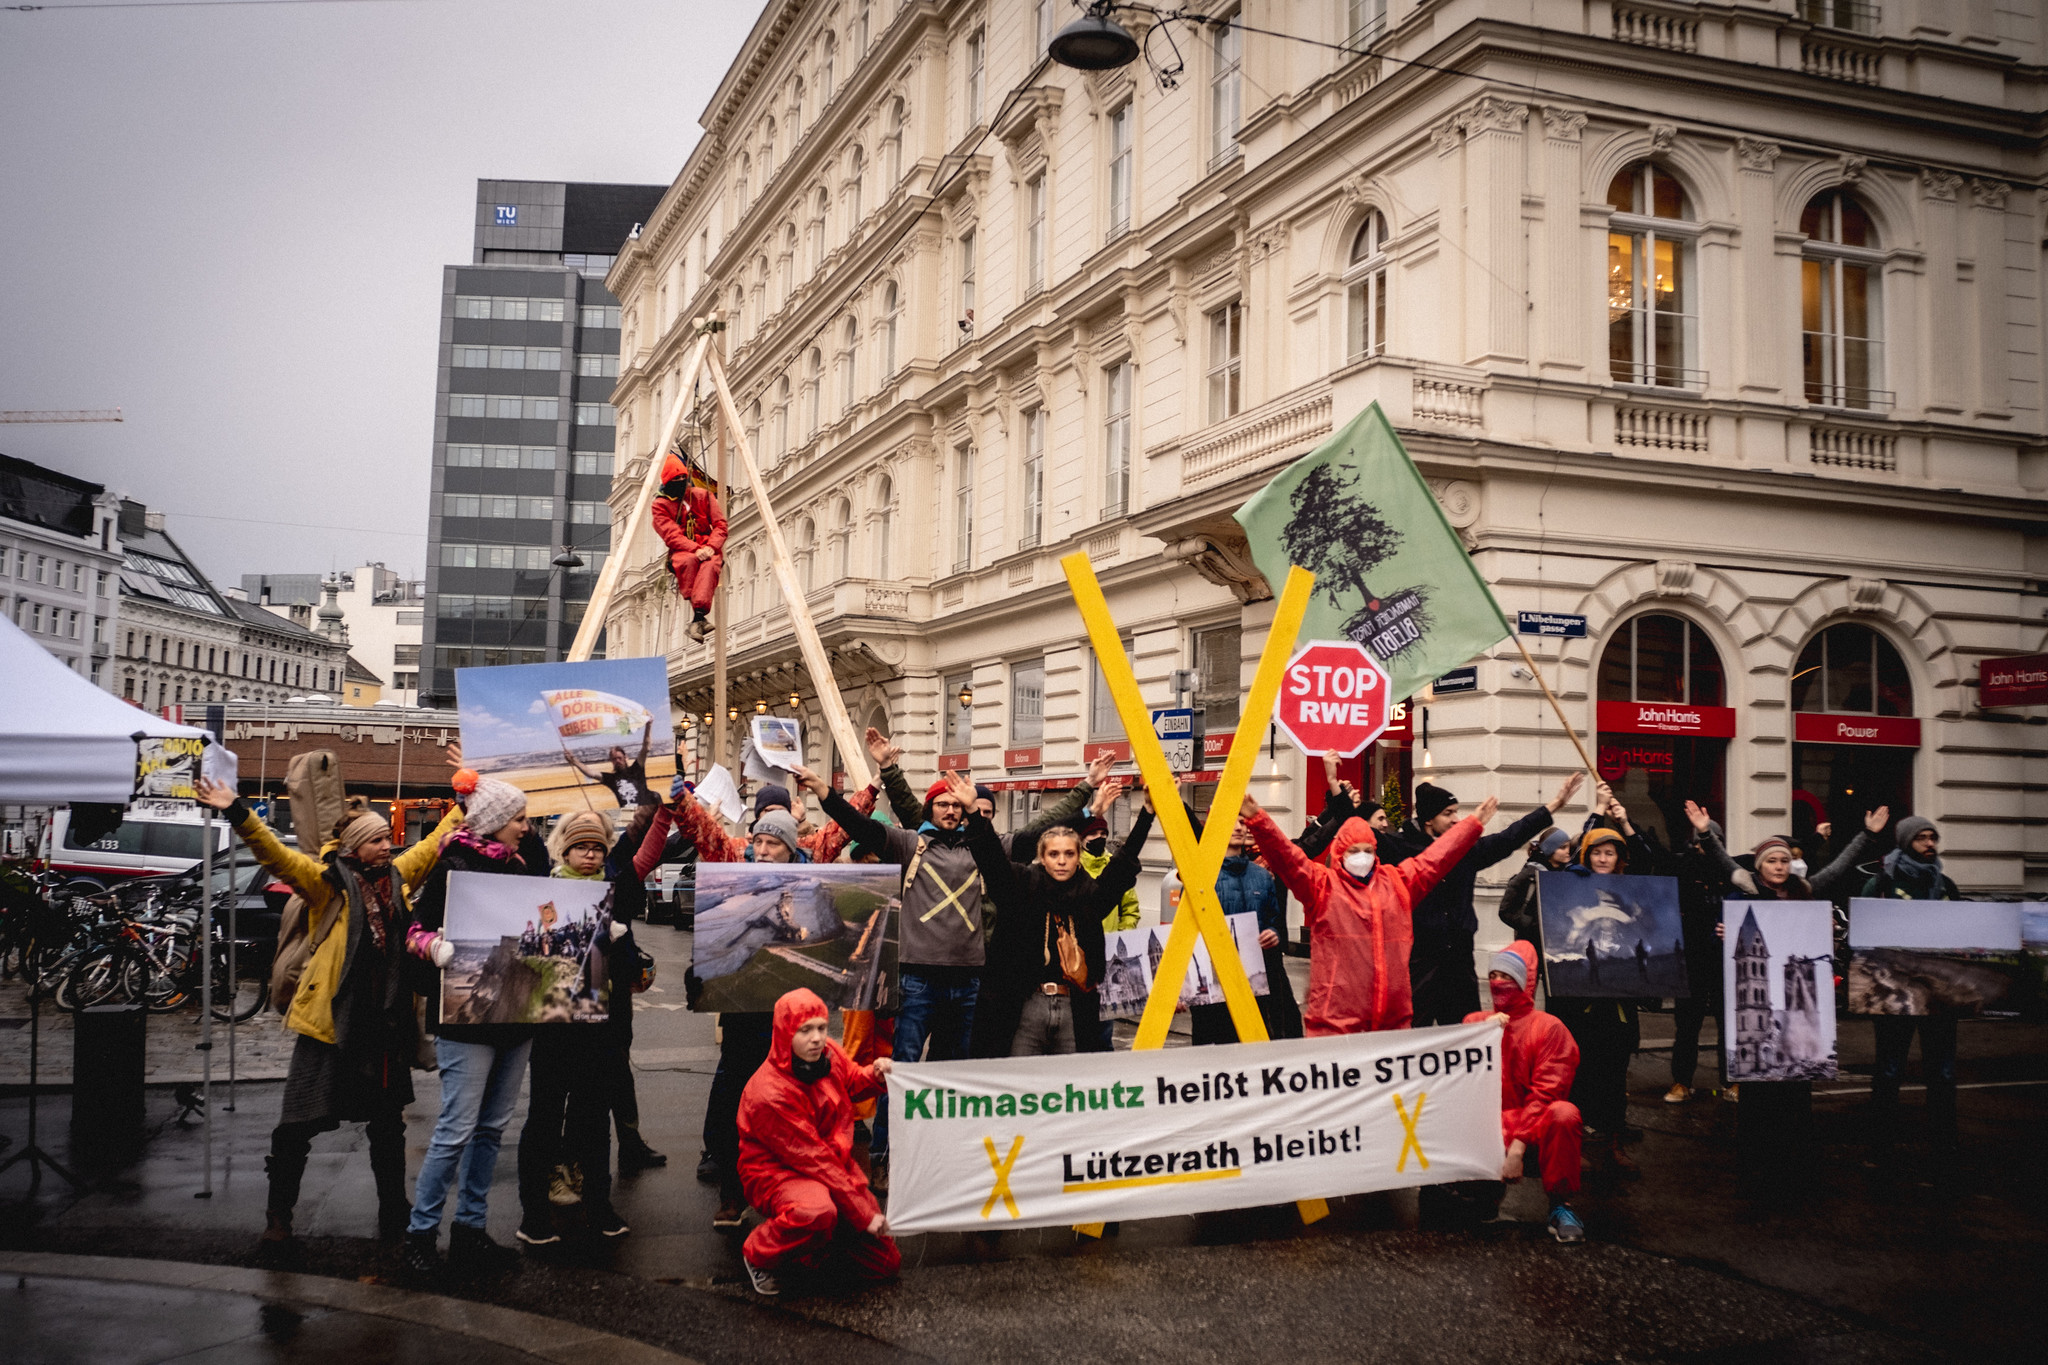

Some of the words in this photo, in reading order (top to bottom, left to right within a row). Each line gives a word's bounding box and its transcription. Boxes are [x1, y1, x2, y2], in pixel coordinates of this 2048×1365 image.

[497, 206, 516, 218] TU
[1540, 625, 1566, 634] gasse
[1289, 664, 1378, 699] STOP
[1988, 672, 2014, 686] John
[2015, 669, 2048, 683] Harris
[555, 690, 583, 702] ALLE
[1299, 701, 1370, 727] RWE
[1164, 717, 1189, 731] EINBAHN
[1836, 722, 1879, 738] Power
[100, 839, 120, 850] 133
[904, 1080, 1145, 1120] Klimaschutz
[1157, 1071, 1249, 1105] heißt
[1261, 1062, 1361, 1096] Kohle
[1374, 1046, 1493, 1084] STOPP!
[1063, 1141, 1240, 1183] Lützerath
[1253, 1125, 1362, 1164] bleibt!
